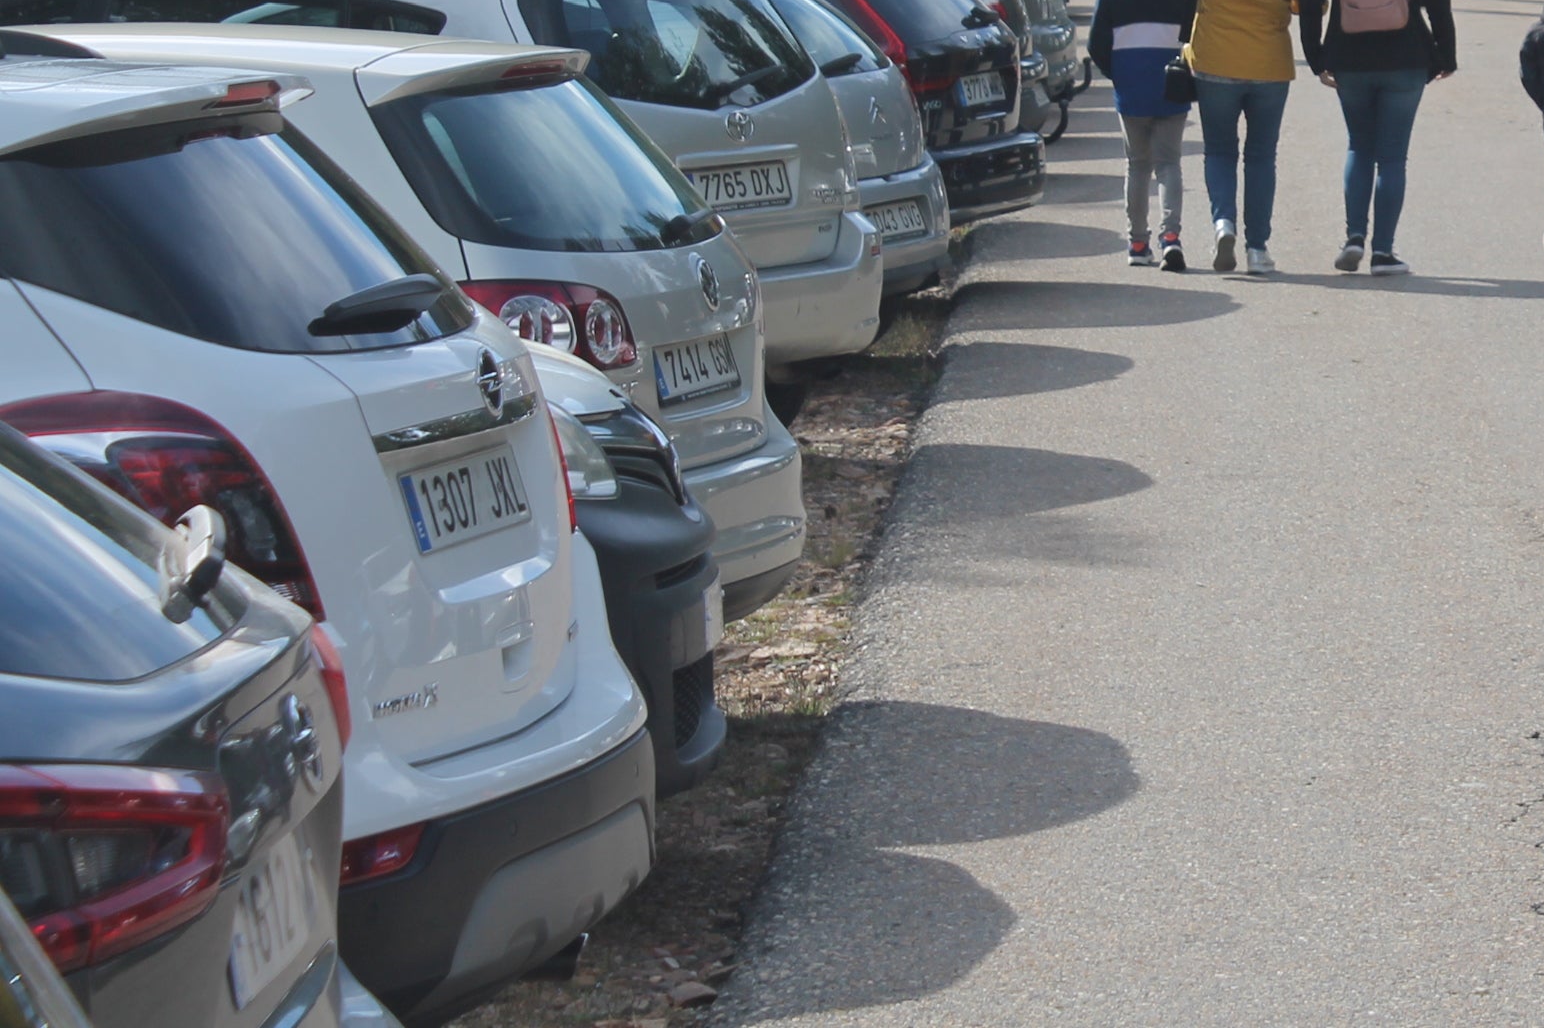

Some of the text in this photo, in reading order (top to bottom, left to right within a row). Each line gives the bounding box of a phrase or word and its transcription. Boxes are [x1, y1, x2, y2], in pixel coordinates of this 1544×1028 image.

[700, 167, 785, 201] 7765 DXJ
[664, 343, 709, 388] 7414
[421, 456, 527, 537] 1307 JXL
